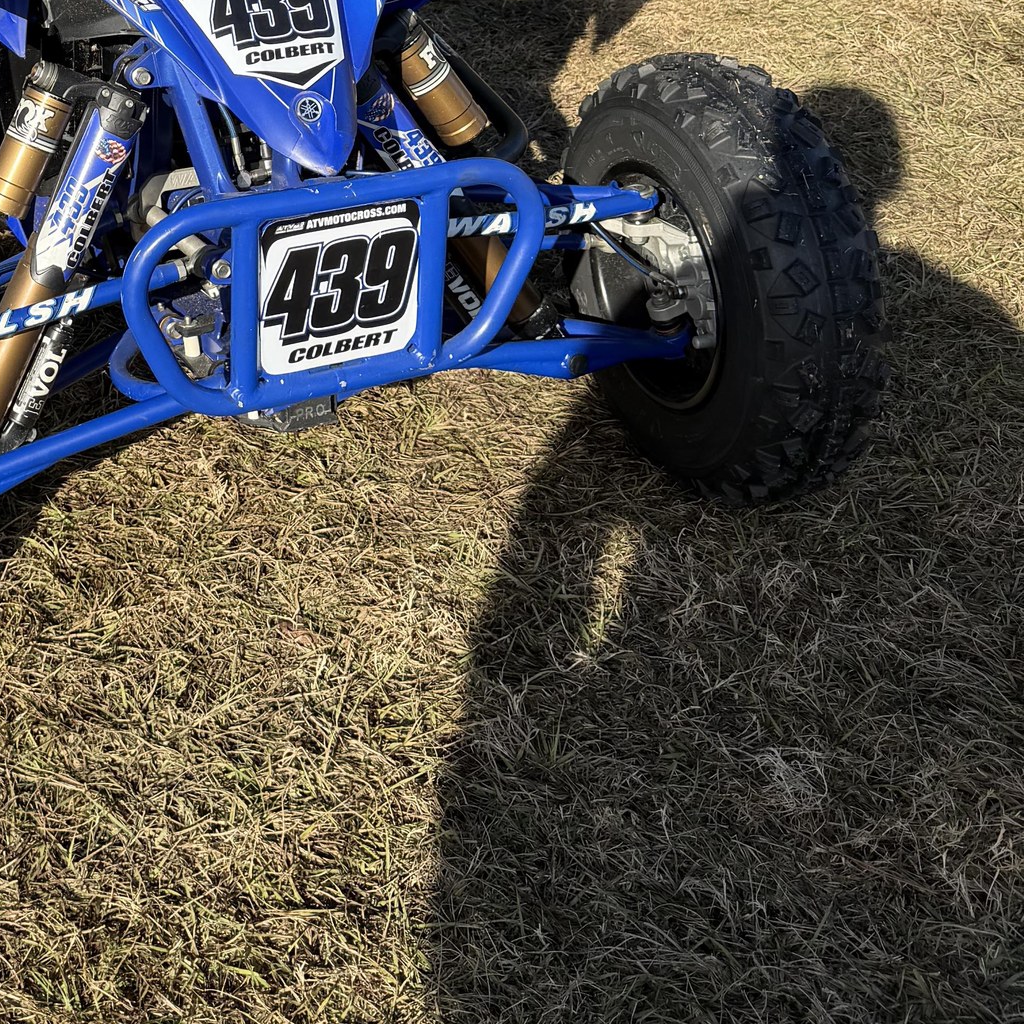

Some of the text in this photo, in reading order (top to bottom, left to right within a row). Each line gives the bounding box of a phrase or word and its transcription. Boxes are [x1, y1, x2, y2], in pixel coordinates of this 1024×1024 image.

[245, 42, 335, 66] COLBERT
[372, 126, 415, 171] COLB
[66, 168, 117, 268] COLBERT
[306, 202, 407, 230] ATVMOTOCROSS.COM
[447, 202, 597, 238] WASH
[262, 225, 419, 347] 439
[288, 328, 398, 364] COLBERT
